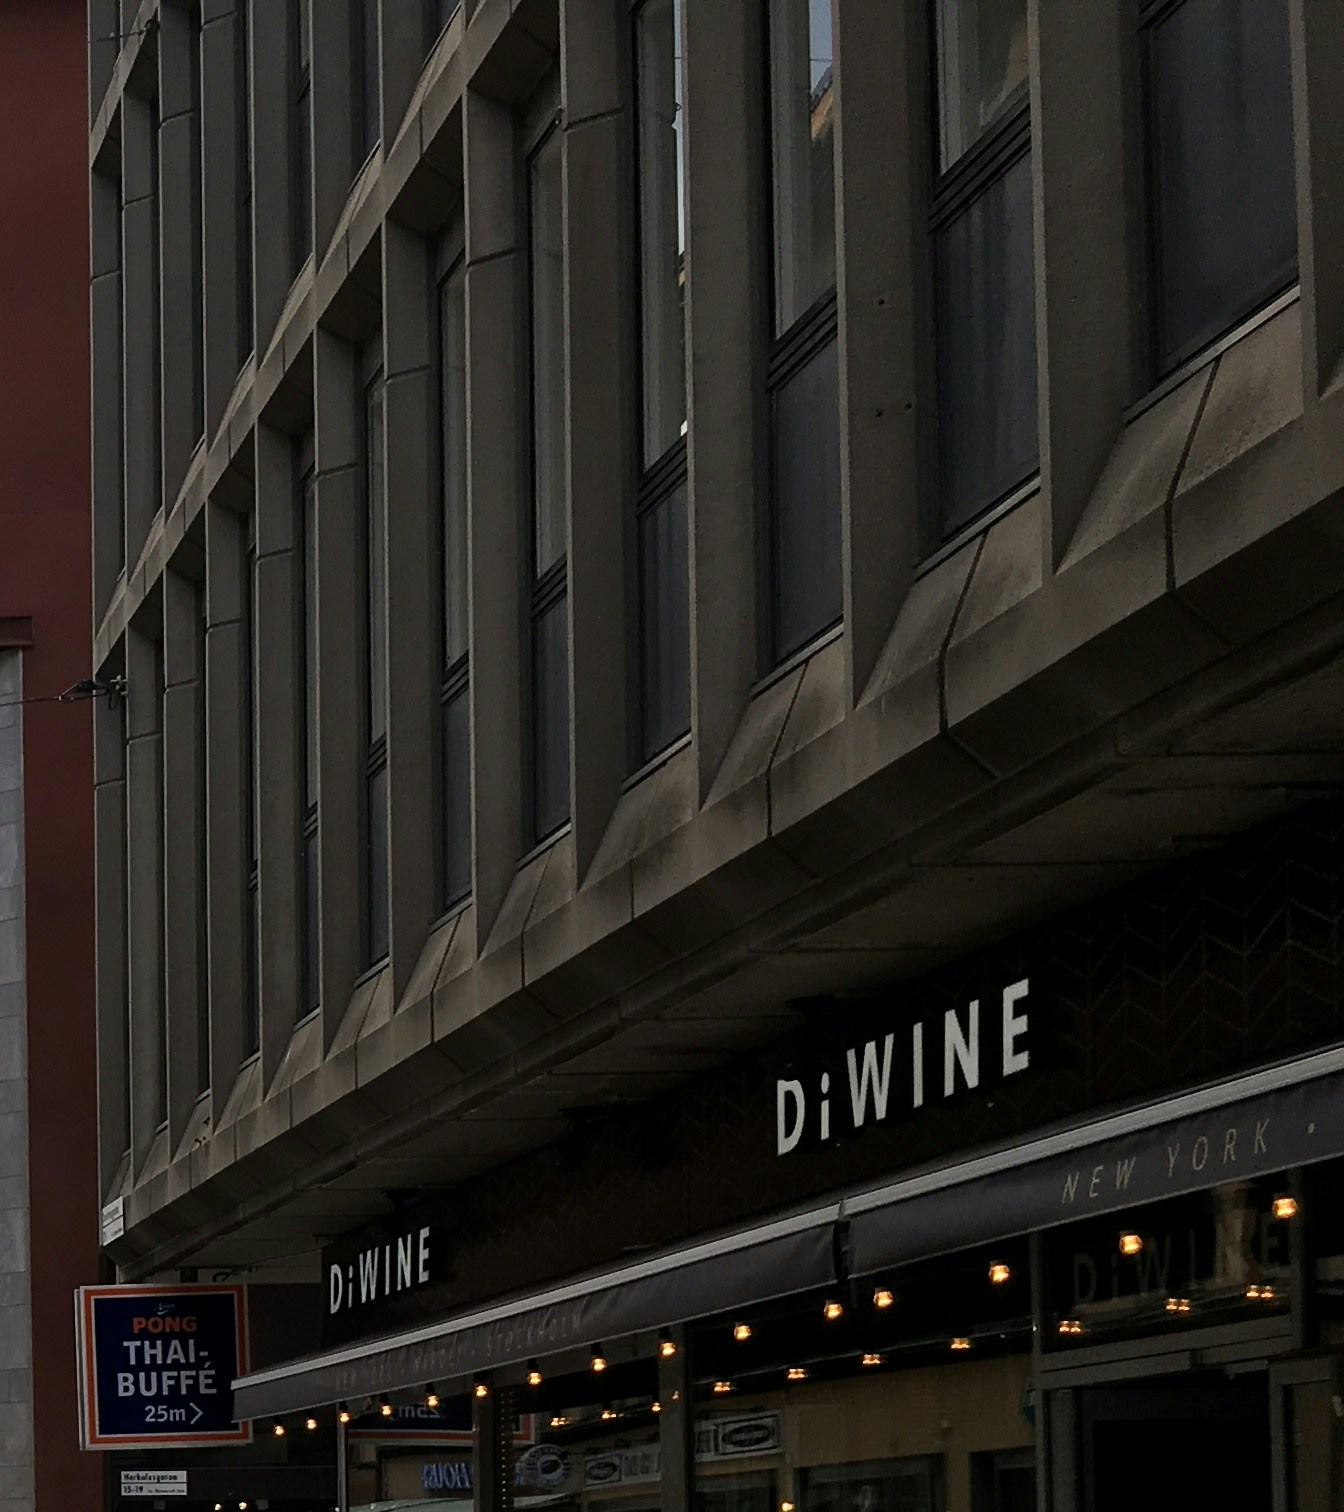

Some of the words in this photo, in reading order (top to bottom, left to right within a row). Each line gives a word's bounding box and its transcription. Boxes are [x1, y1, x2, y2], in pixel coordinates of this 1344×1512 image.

[777, 978, 1031, 1157] DiWINE
[1061, 1157, 1136, 1205] NEW
[1166, 1117, 1271, 1177] YORK
[329, 1225, 431, 1315] DiWINE
[131, 1315, 199, 1334] PONG
[122, 1338, 209, 1366] THAI-
[116, 1361, 218, 1398] BUFFÉ
[144, 1405, 186, 1423] 25m
